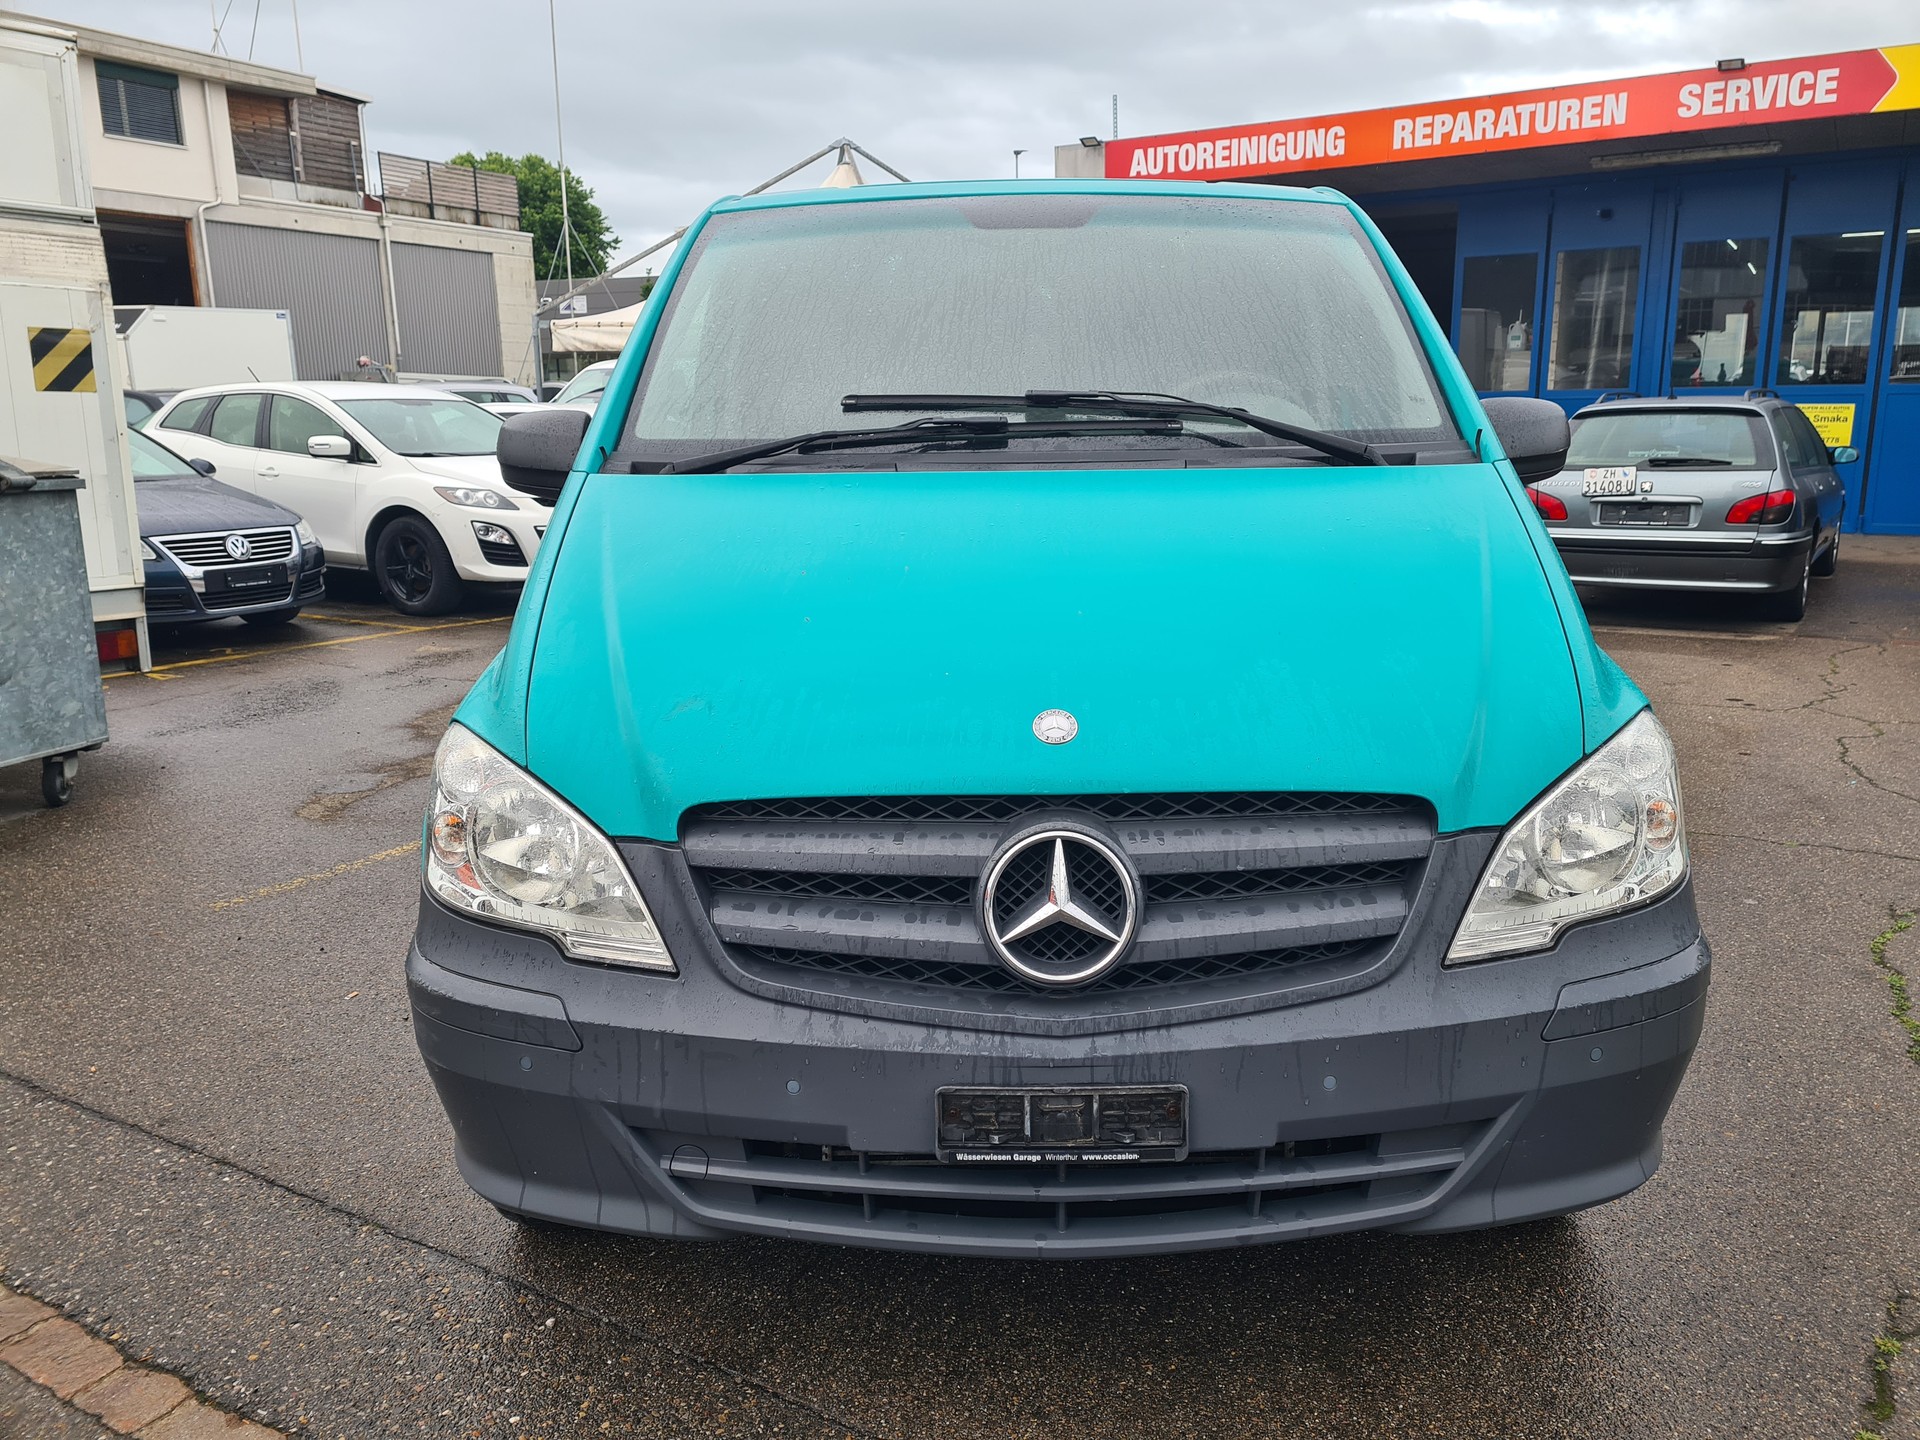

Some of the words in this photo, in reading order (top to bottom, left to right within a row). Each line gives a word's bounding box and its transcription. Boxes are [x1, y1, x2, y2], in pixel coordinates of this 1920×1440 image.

[1129, 125, 1346, 179] AUTOREINIGUNG
[1392, 92, 1628, 151] REPARATUREN
[1677, 67, 1841, 119] SERVICE
[1813, 414, 1848, 423] Smaka
[1602, 469, 1617, 479] ZH
[1013, 1153, 1042, 1163] Garage
[1044, 1153, 1078, 1161] Winterthur
